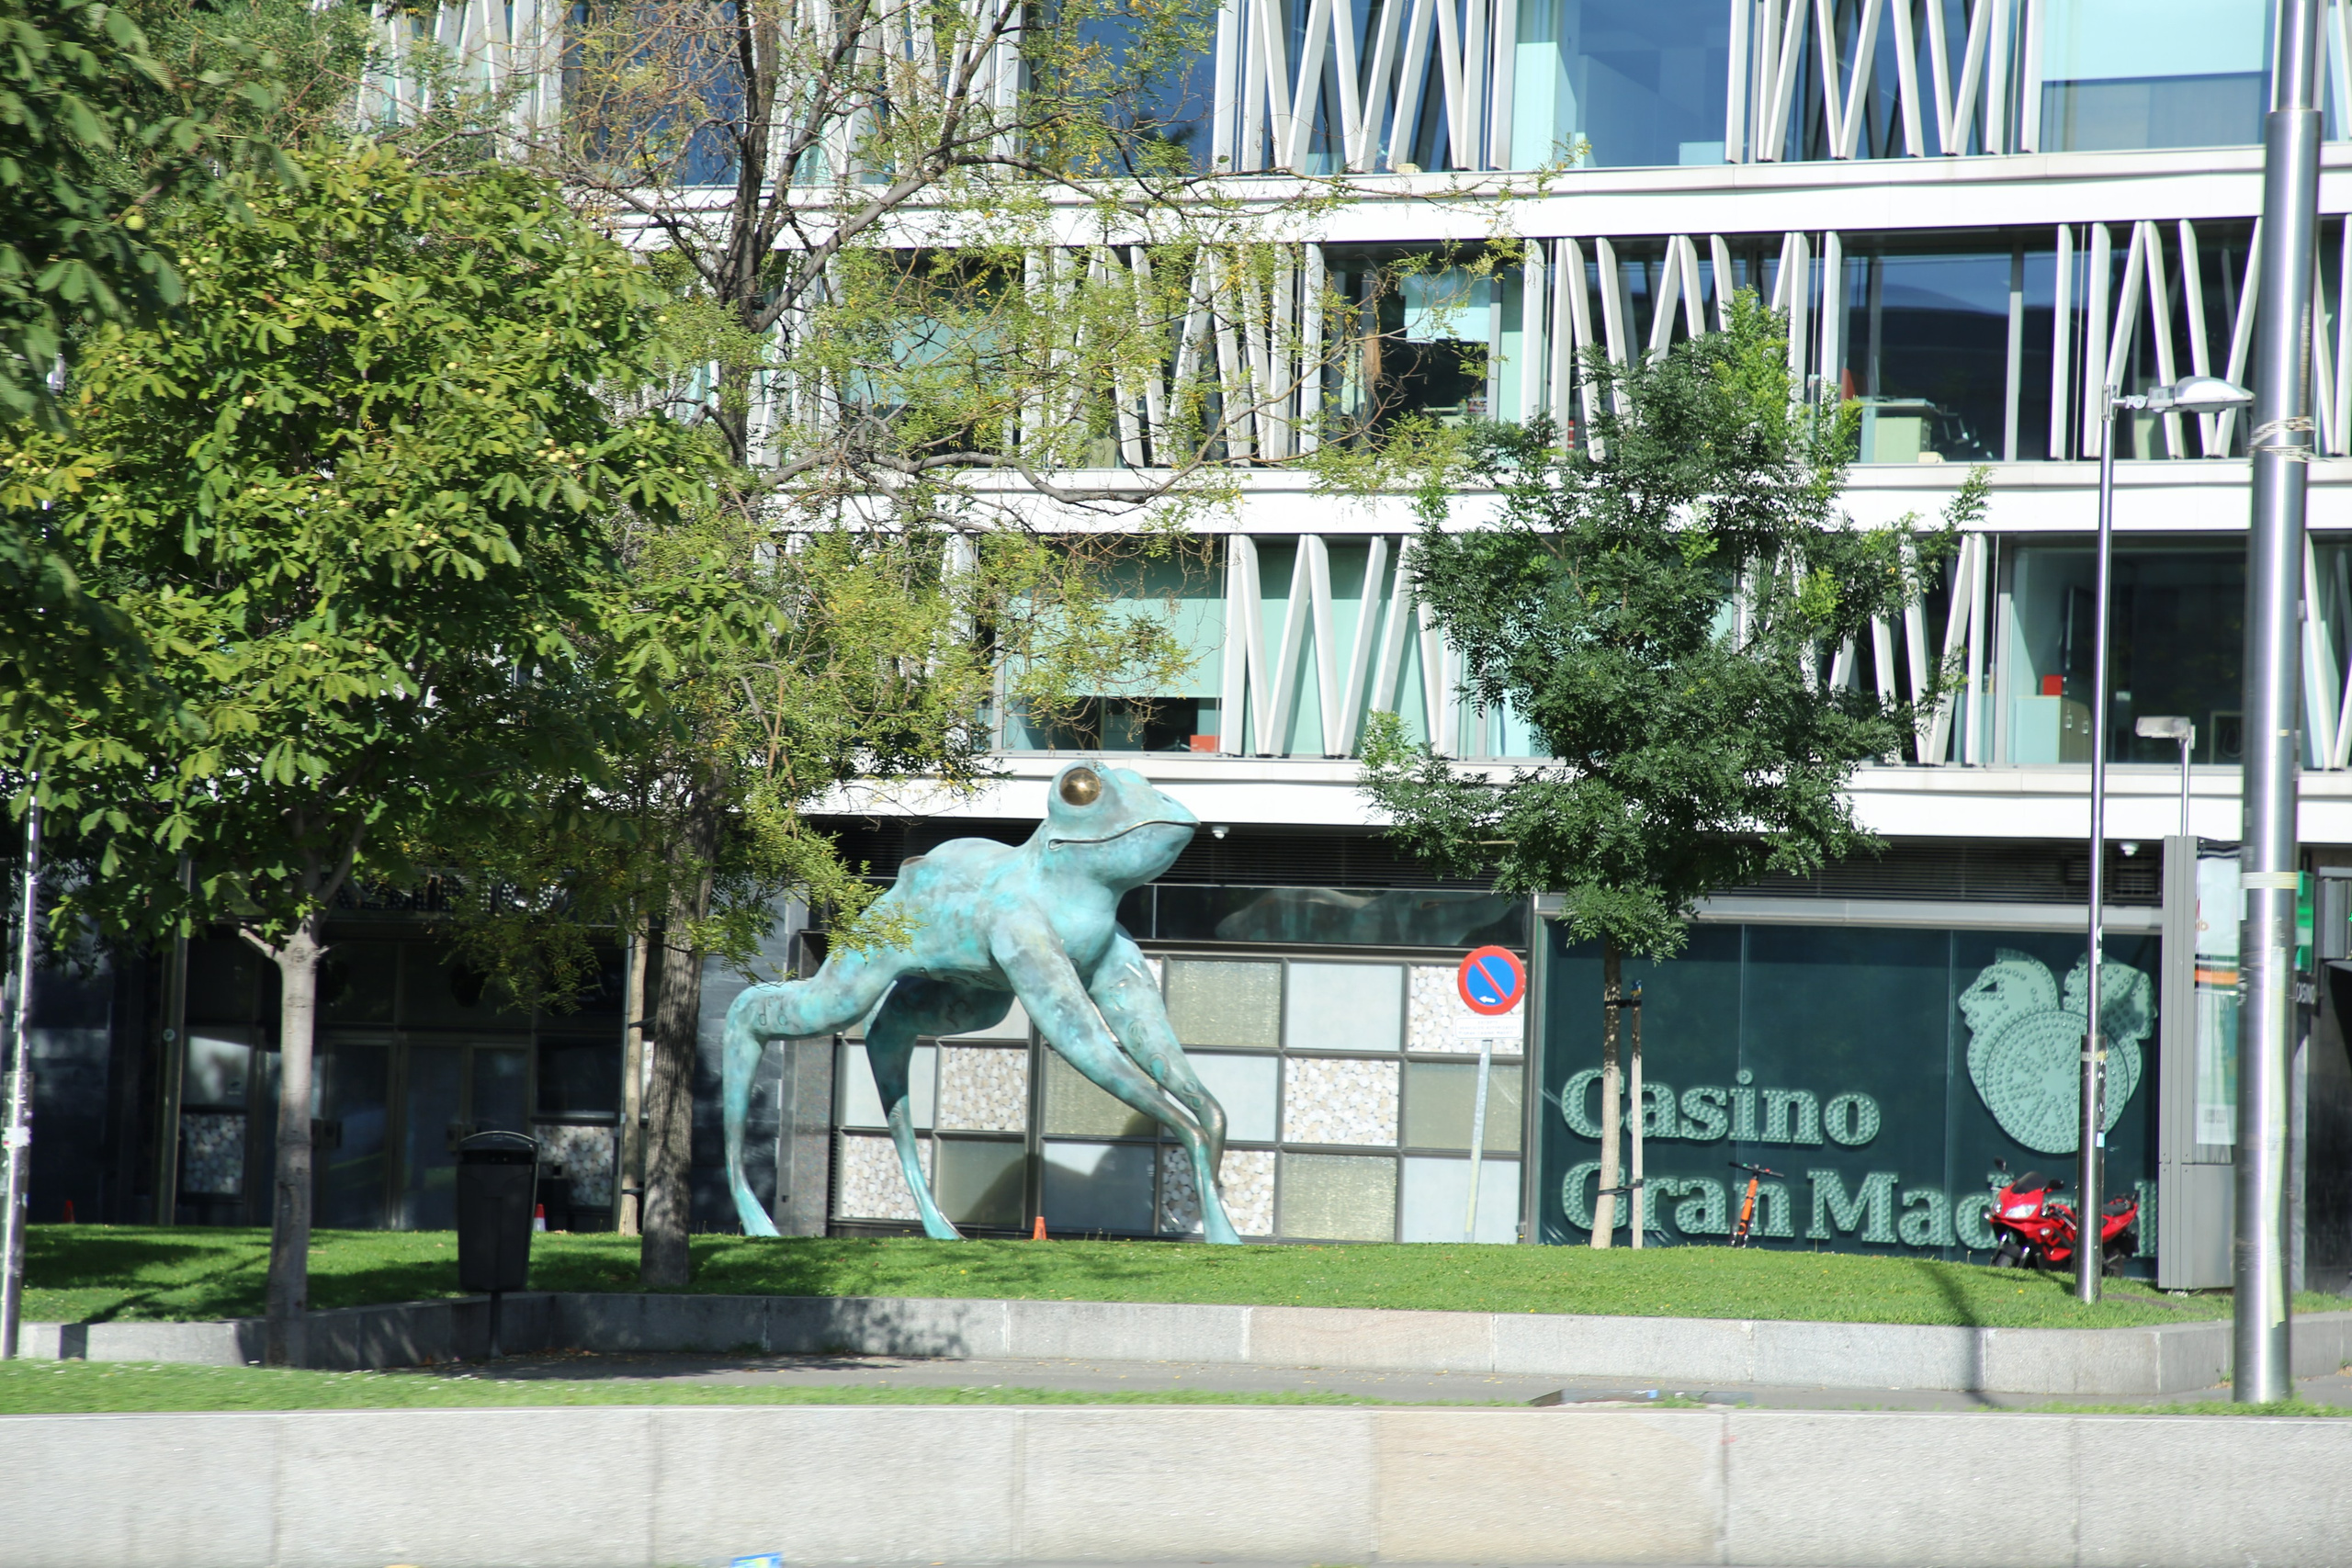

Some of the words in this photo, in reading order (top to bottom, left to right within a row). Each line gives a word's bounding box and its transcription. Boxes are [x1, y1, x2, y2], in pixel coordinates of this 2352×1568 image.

[1562, 1067, 1881, 1145] Casino
[1563, 1160, 1794, 1237] Gran
[1805, 1168, 2157, 1258] Mad
